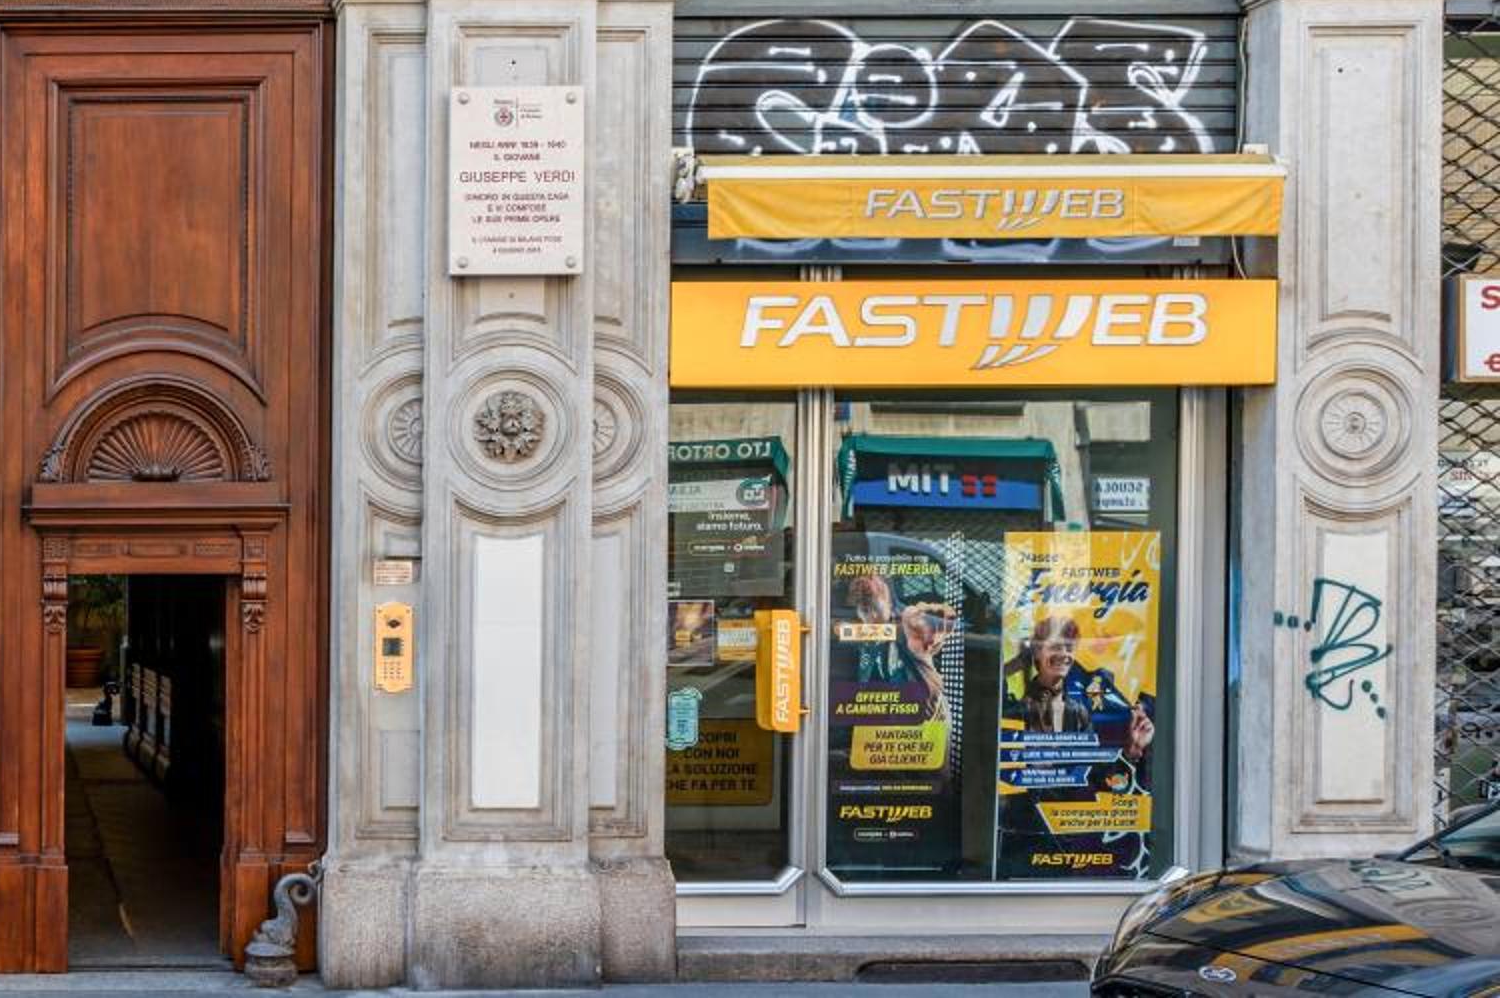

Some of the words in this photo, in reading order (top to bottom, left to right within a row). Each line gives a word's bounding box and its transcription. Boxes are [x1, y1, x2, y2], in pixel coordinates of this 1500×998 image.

[459, 171, 527, 183] GIUSEPPE
[533, 170, 575, 183] VERDI
[865, 189, 1125, 231] FASTWEB
[740, 294, 1207, 370] FASTWEB
[835, 564, 887, 576] FASTWEB
[890, 564, 941, 576] ENERGIA
[1061, 568, 1120, 578] FASTWEB
[776, 619, 791, 723] FASTWEB
[856, 692, 900, 703] OFFERTE
[846, 704, 888, 715] CANONE
[890, 704, 919, 715] FISSO
[698, 731, 736, 743] COPRI
[684, 748, 712, 759] CON
[716, 748, 740, 759] NOI
[685, 763, 756, 775] SOLUZIONE
[712, 779, 734, 791] PER
[839, 806, 932, 822] FASTWEB
[1032, 853, 1114, 869] FASTWEB
